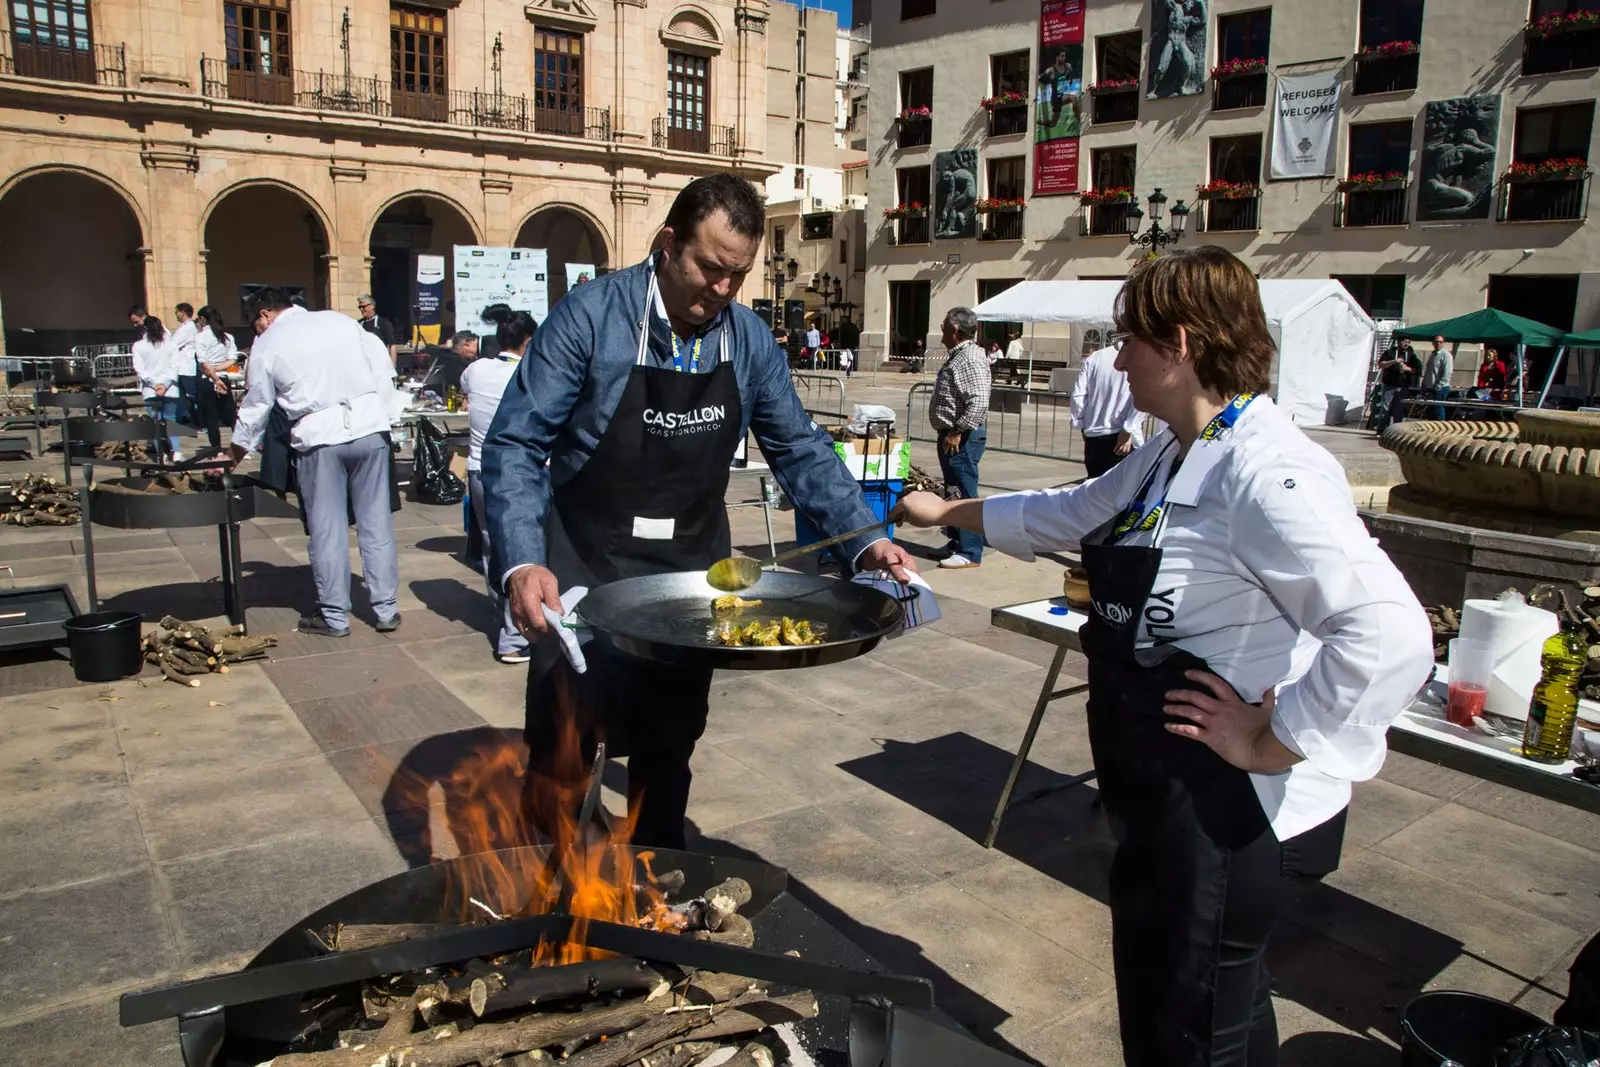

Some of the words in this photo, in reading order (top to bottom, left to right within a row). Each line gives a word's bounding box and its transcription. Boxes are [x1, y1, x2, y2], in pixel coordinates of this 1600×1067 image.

[1282, 87, 1336, 101] REFUGEES
[1280, 104, 1335, 117] WELCOME
[643, 404, 725, 429] CASTELLÓN
